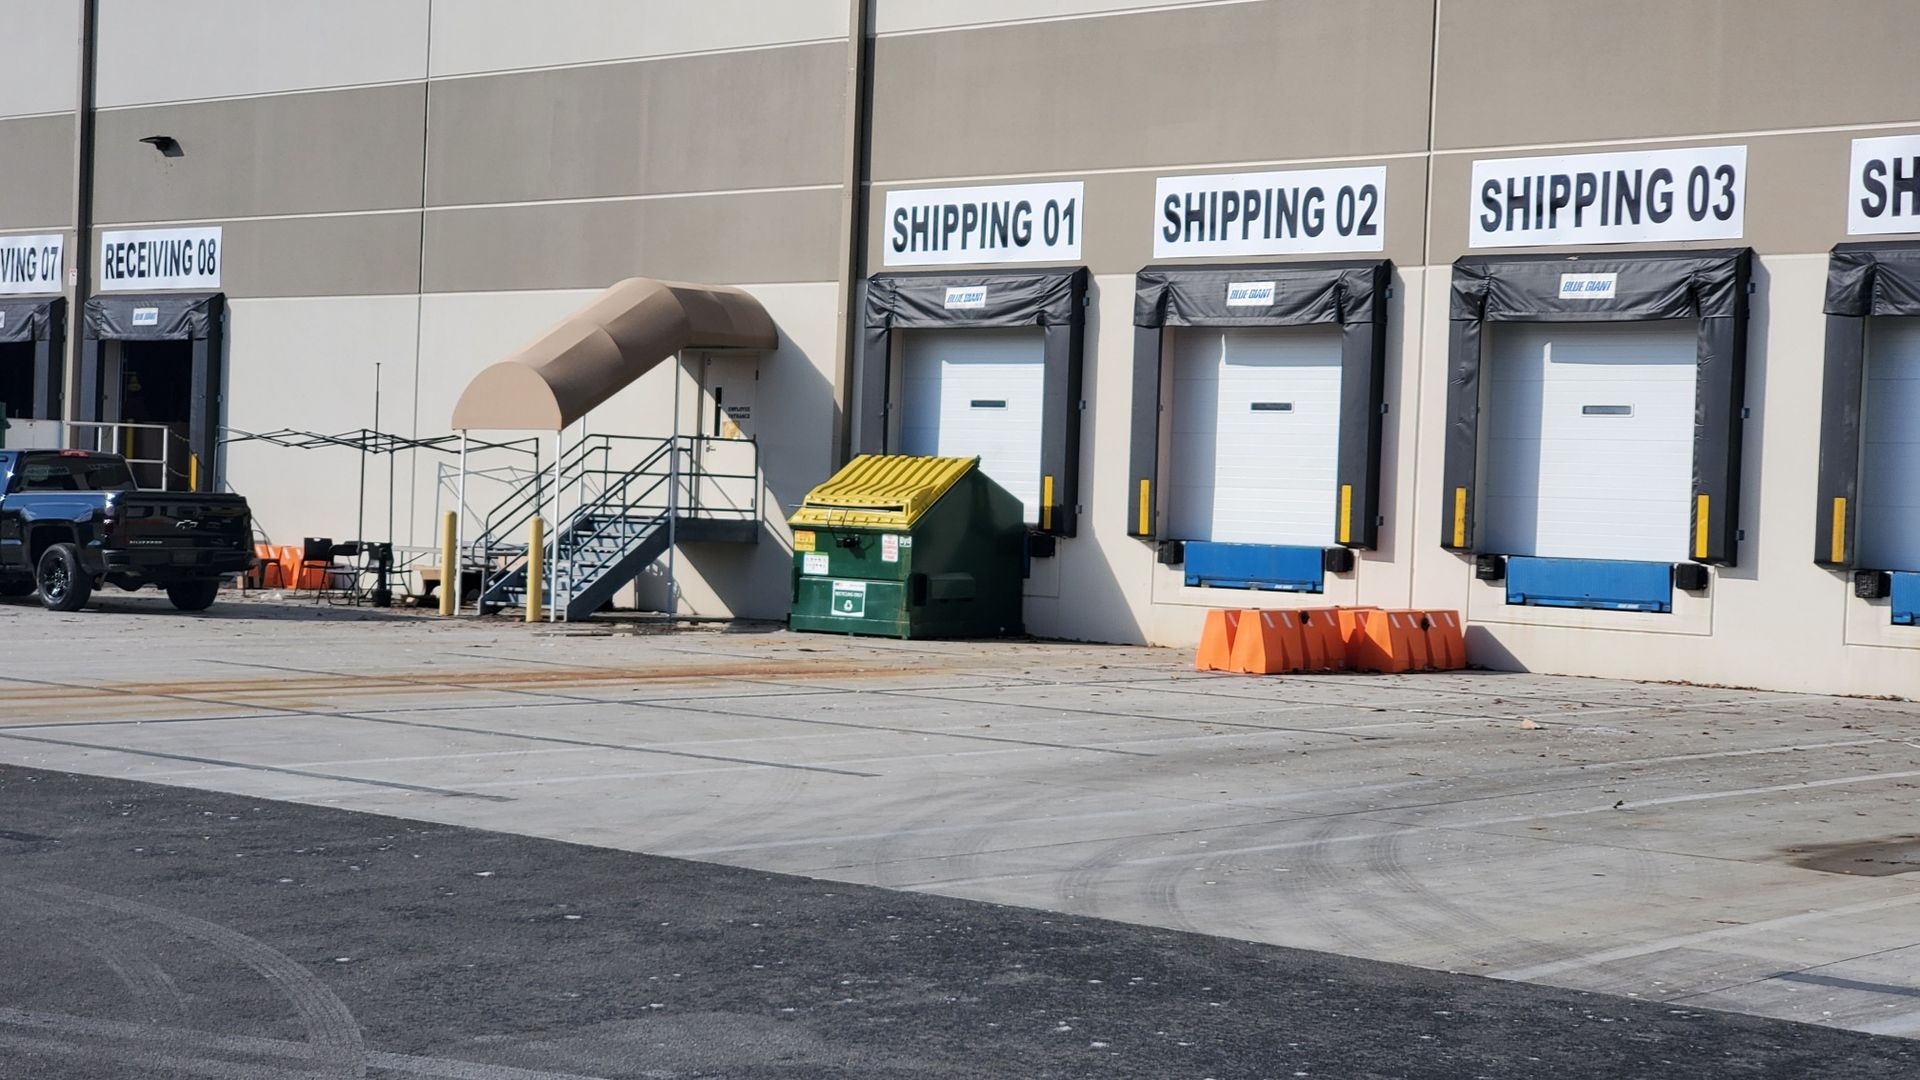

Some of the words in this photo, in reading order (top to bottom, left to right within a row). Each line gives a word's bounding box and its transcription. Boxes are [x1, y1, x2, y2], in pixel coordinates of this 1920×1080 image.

[1480, 167, 1674, 233] SHIPPING
[1687, 164, 1736, 222] 03
[1860, 156, 1920, 218] SH
[892, 199, 1033, 253] SHIPPING
[1043, 197, 1076, 247] 01
[1162, 186, 1326, 243] SHIPPING
[1335, 183, 1378, 237] 02
[41, 246, 59, 281] 07
[105, 239, 193, 279] RECEIVING
[198, 238, 216, 275] 08
[1230, 289, 1249, 300] BLUE
[1249, 288, 1272, 299] GIANT
[1562, 280, 1585, 292] BLUE
[1585, 280, 1613, 292] GIANT
